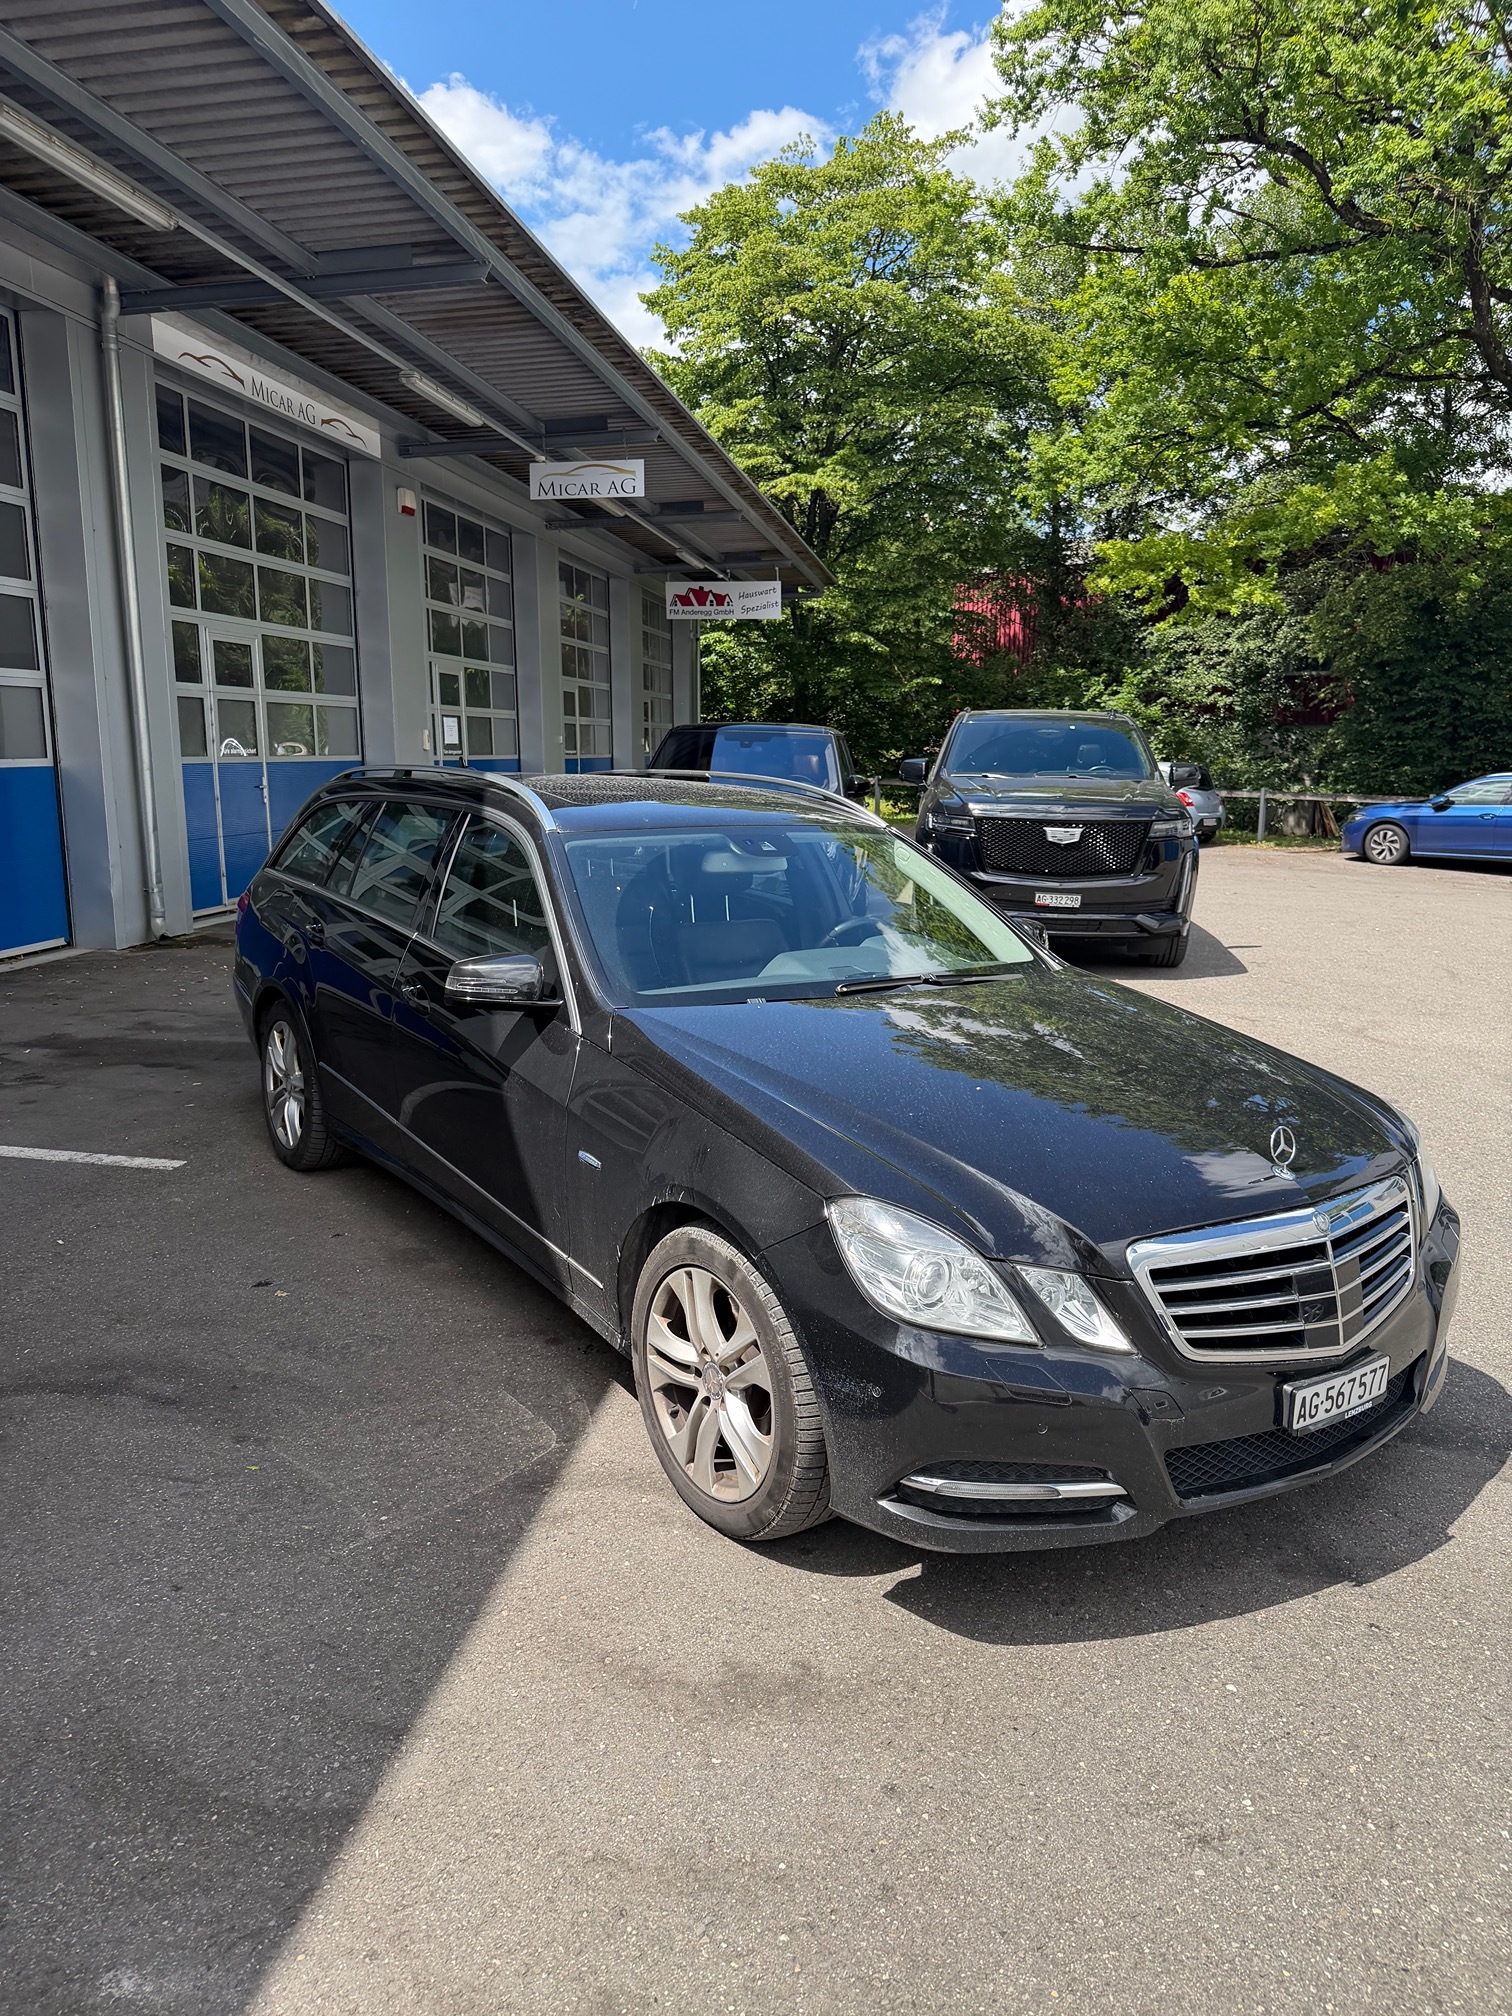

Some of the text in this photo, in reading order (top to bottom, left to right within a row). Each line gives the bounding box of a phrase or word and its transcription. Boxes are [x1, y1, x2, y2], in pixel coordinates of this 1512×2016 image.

[298, 402, 316, 425] AG
[607, 478, 636, 495] AG
[738, 587, 777, 600] Hauswart
[681, 609, 712, 617] Anderegg
[741, 601, 779, 615] Spezialist
